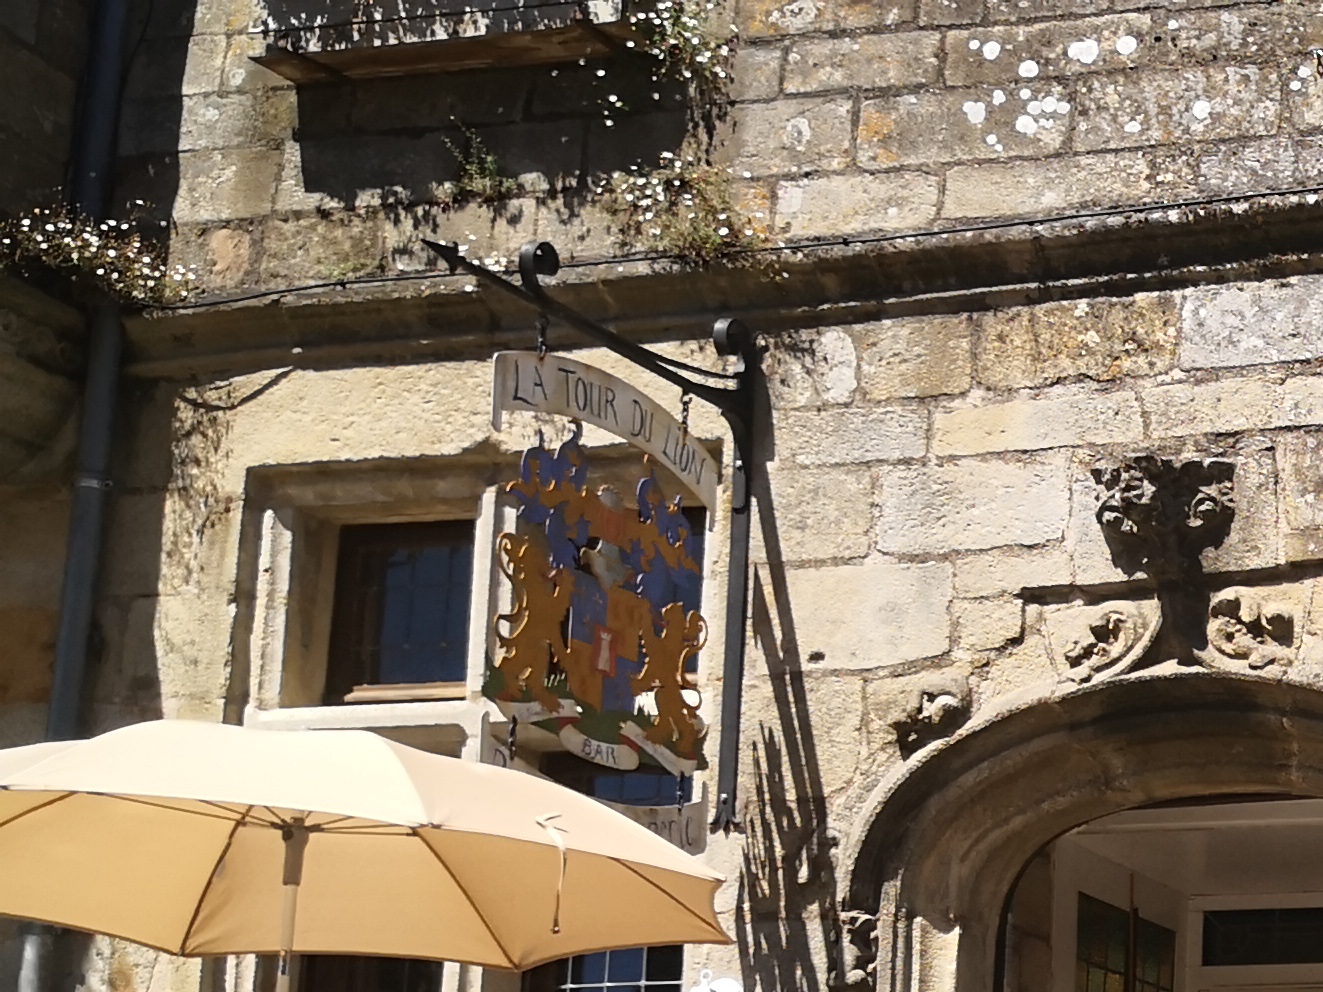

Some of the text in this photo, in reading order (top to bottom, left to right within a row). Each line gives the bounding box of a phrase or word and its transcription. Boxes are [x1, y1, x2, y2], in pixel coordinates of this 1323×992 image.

[513, 359, 706, 486] LA TOUR DU LION
[581, 737, 617, 766] BAR
